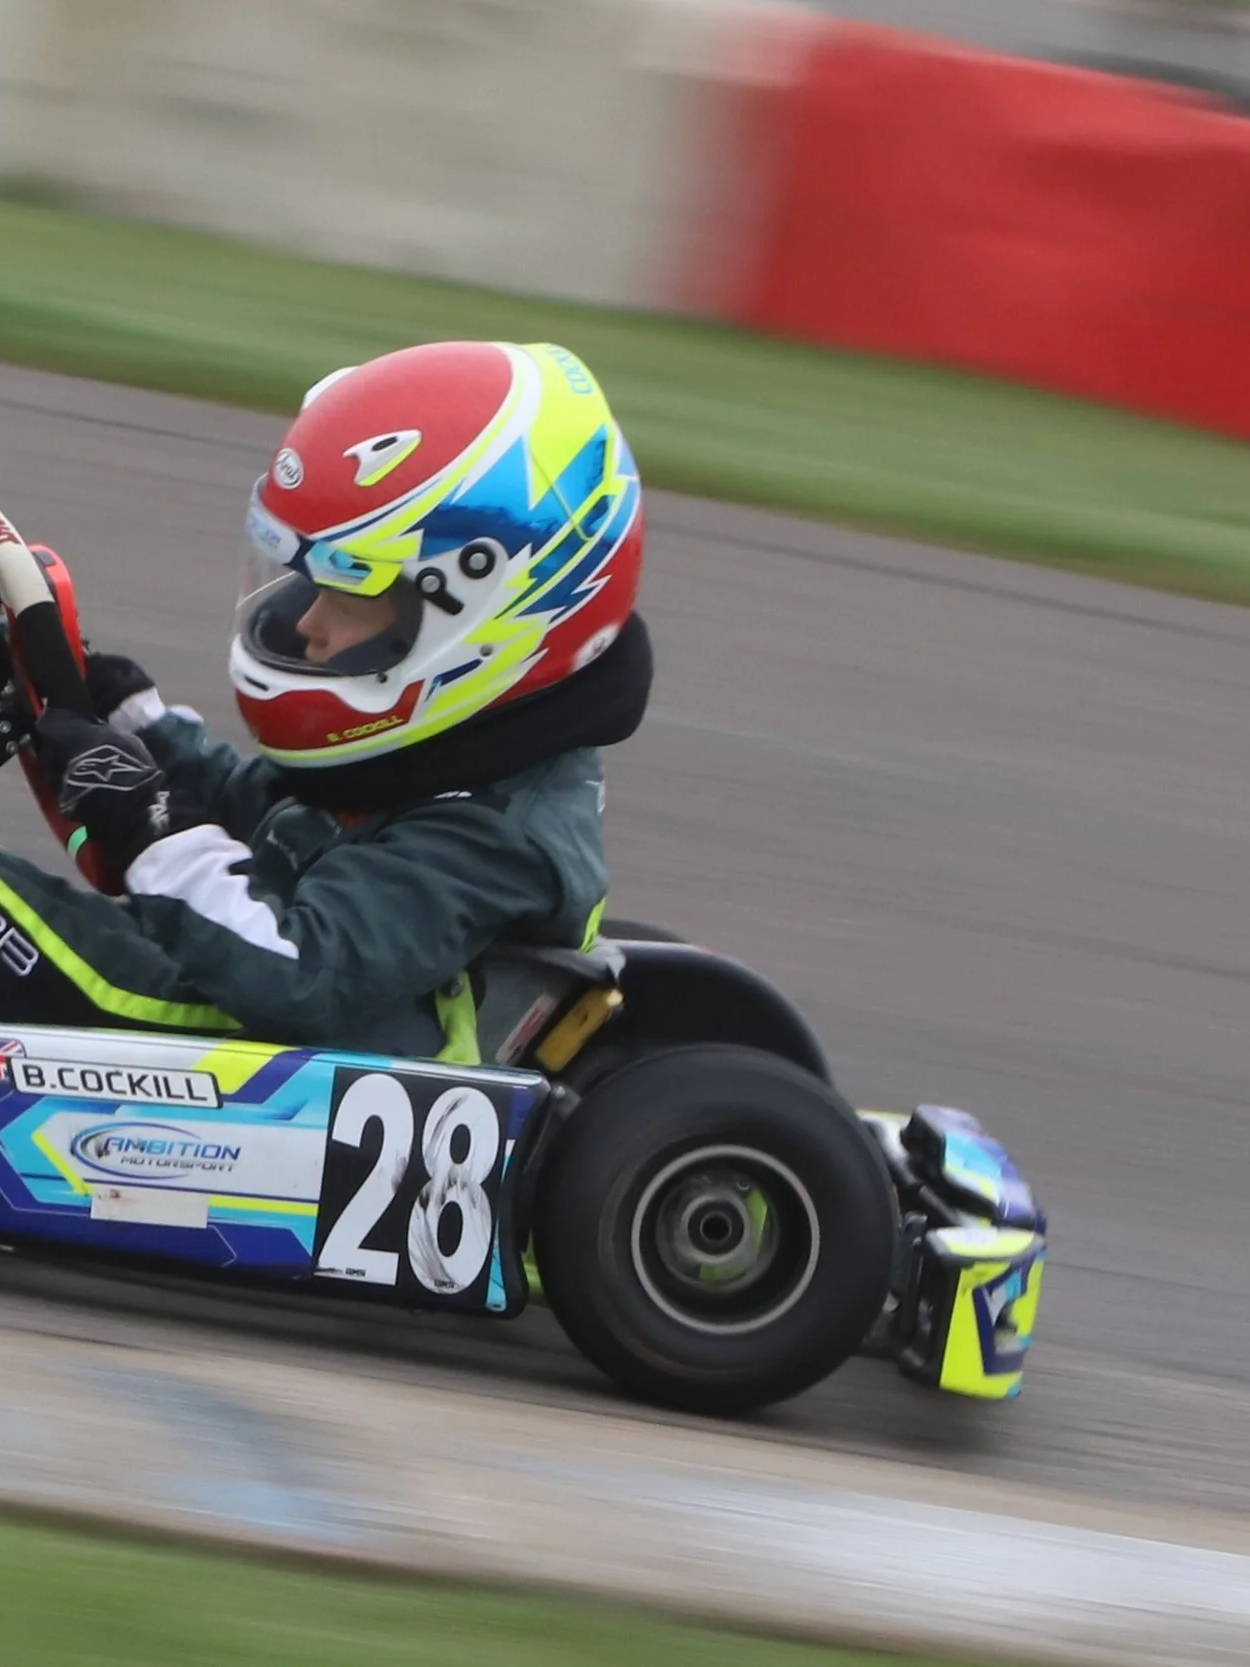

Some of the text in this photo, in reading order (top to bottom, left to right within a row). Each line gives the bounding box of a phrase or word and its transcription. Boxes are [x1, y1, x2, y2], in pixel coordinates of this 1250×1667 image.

[21, 1064, 208, 1102] B.COCKILL
[103, 1136, 242, 1161] AMBITION
[121, 1156, 235, 1172] MOTORSPORT
[314, 1073, 500, 1294] 28
